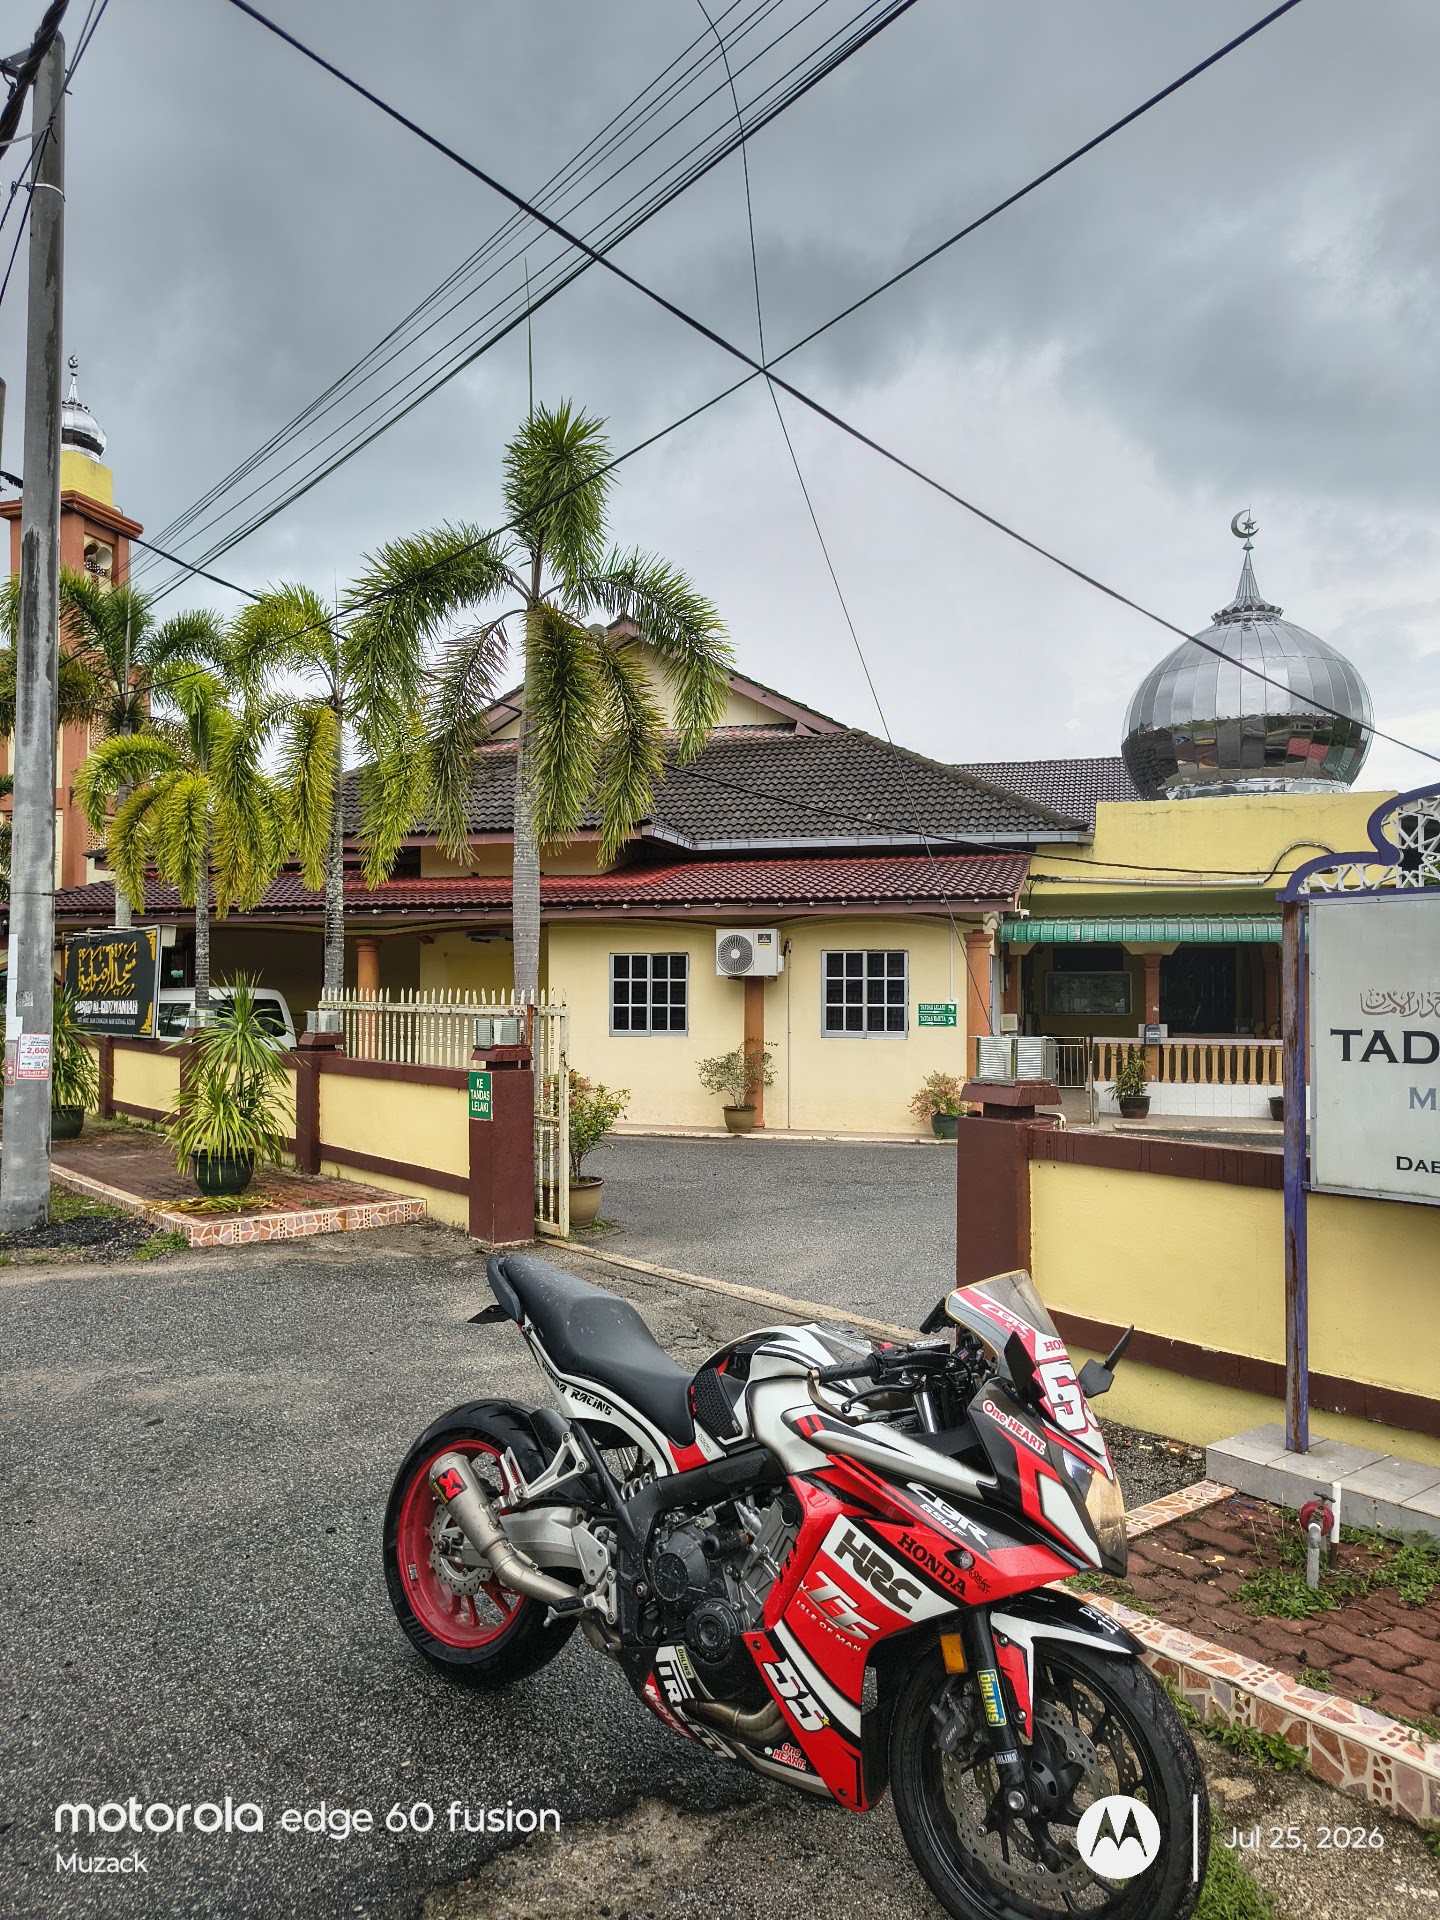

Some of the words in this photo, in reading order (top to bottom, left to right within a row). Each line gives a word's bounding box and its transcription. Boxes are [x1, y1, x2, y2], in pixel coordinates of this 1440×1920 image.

[470, 1089, 490, 1102] TANDAS
[476, 1078, 484, 1089] KE
[471, 1100, 489, 1113] LELAKI
[984, 1401, 1007, 1424] One
[906, 1481, 989, 1549] CBR
[834, 1528, 922, 1614] HRC
[897, 1531, 968, 1597] HONDA
[796, 1599, 818, 1622] ISLE
[819, 1620, 834, 1639] OF
[835, 1633, 862, 1652] MAN
[763, 1658, 830, 1732] 55
[782, 1742, 802, 1758] One
